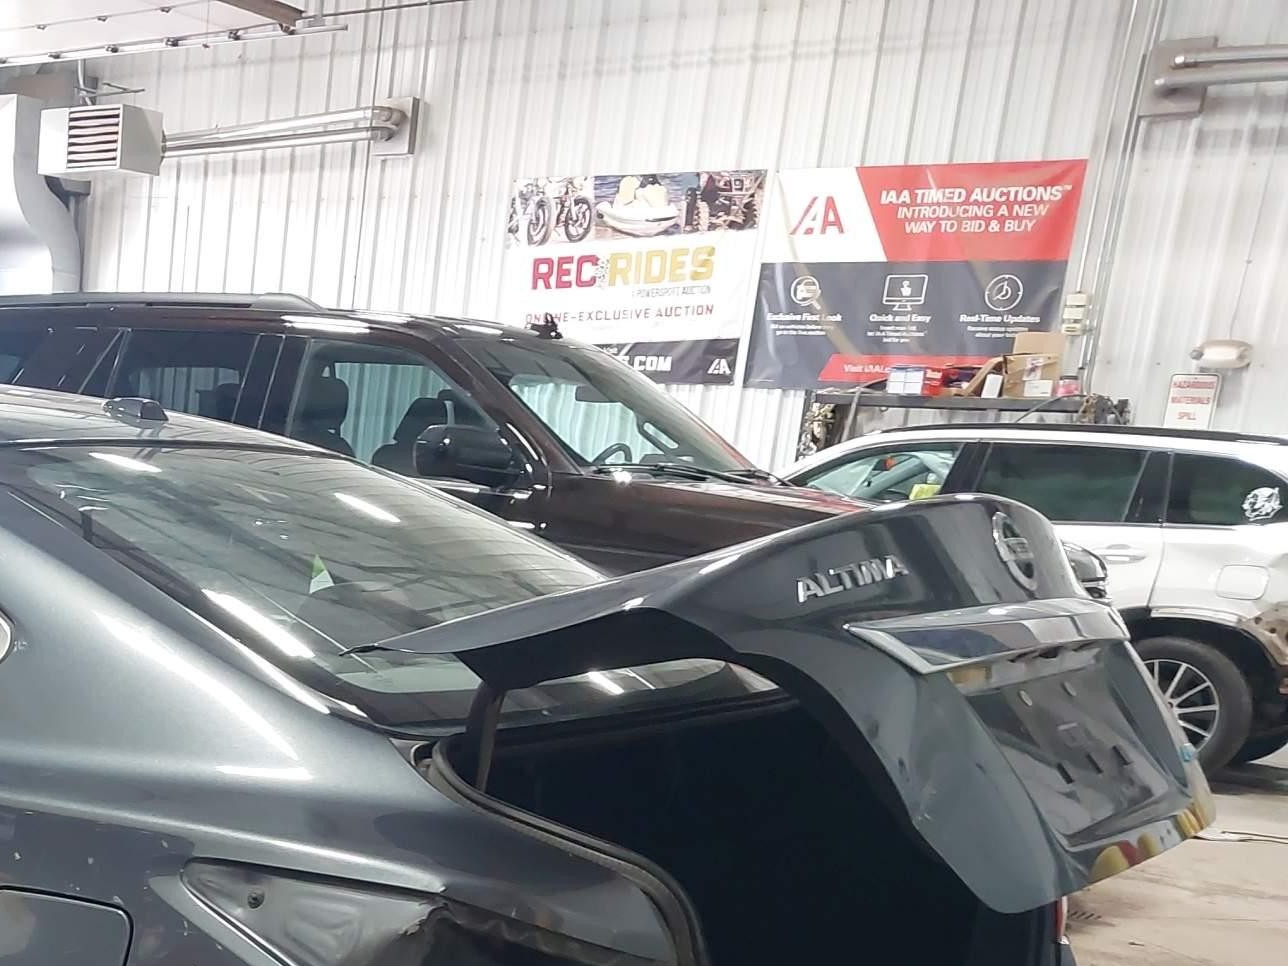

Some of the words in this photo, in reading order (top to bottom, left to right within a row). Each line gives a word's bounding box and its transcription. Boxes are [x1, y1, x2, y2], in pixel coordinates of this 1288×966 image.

[880, 190, 910, 204] IAA
[915, 188, 966, 204] TIMED
[897, 204, 994, 219] INTRODUCING
[997, 204, 1009, 217] A
[1013, 203, 1049, 217] NEW
[904, 220, 938, 233] WAY
[939, 220, 958, 233] TO
[961, 219, 984, 233] BID
[988, 220, 1000, 232] &
[1004, 219, 1036, 232] BUY
[532, 254, 600, 290] REC
[608, 246, 716, 287] RIDES
[525, 306, 650, 323] ONNE-EXCLUSIVE
[655, 304, 714, 318] AUCTION
[911, 313, 932, 324] Easy
[797, 555, 909, 602] ALTIMA
